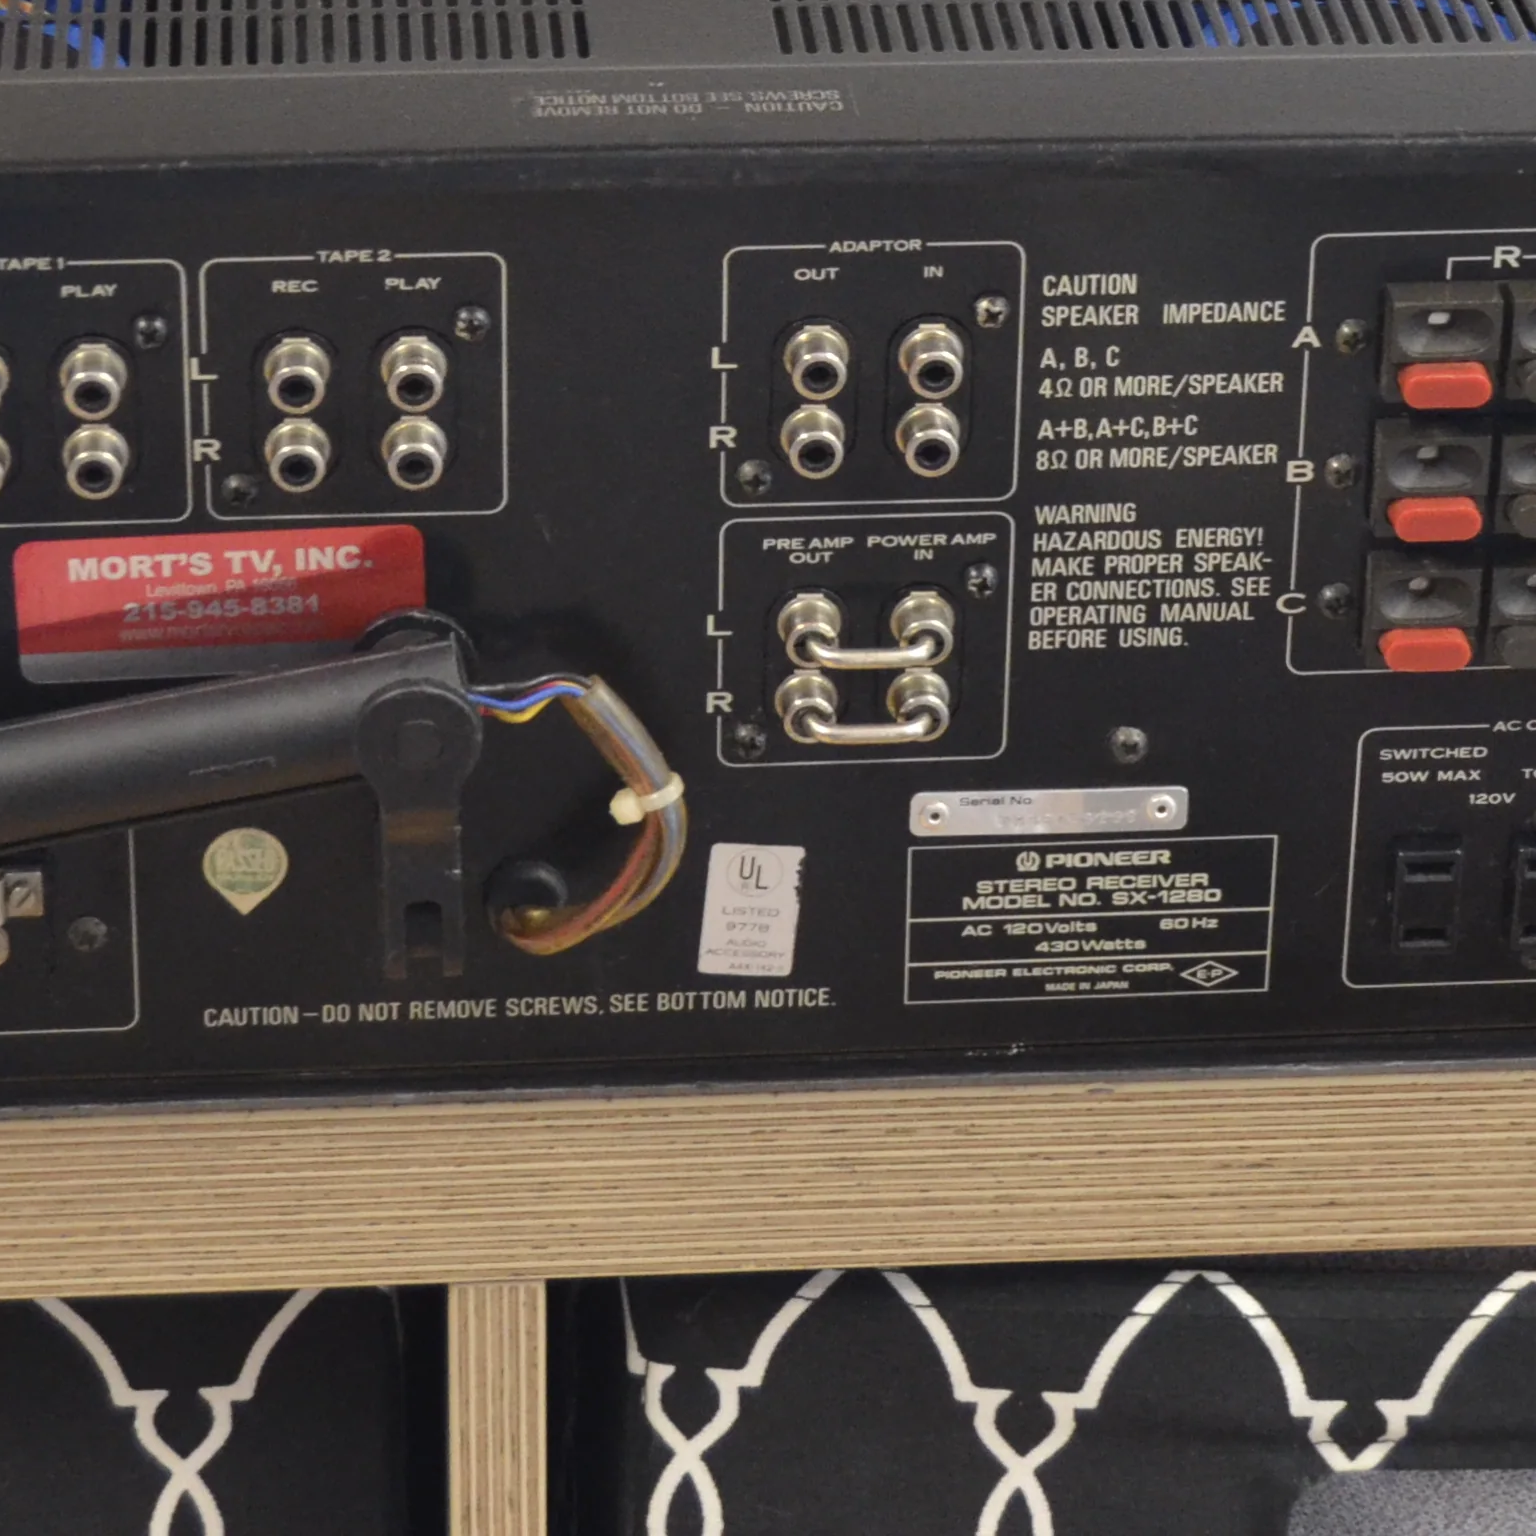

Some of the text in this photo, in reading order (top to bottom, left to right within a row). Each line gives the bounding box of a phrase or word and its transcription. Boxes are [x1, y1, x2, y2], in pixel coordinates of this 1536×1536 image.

[610, 91, 701, 105] BOTTOM
[744, 101, 845, 114] CAUTION
[531, 103, 620, 118] REMOVE
[626, 102, 667, 116] NOT
[673, 102, 704, 115] DO
[316, 249, 392, 263] TAPE 2
[829, 239, 922, 253] ADAPTOR
[55, 257, 65, 270] 1
[1493, 246, 1522, 268] R
[794, 267, 840, 282] OUT
[923, 265, 944, 279] IN
[60, 283, 117, 298] PLAY
[271, 279, 319, 294] REC
[384, 277, 441, 292] PLAY
[1043, 274, 1137, 297] CAUTION
[1041, 300, 1287, 328] SPEAKER IMPEDANCE
[1292, 326, 1322, 349] A
[710, 347, 738, 371] L
[1106, 346, 1120, 367] C
[190, 357, 218, 380] L
[1080, 376, 1107, 399] OR
[1114, 372, 1285, 398] MORE/SPEAKER
[709, 426, 738, 450] R
[193, 439, 222, 463] R
[1074, 448, 1102, 471] OR
[1109, 443, 1279, 470] MORE/SPEAKER
[1285, 460, 1315, 482] B
[1035, 503, 1137, 525] WARNING
[763, 536, 854, 551] PRE AMP
[867, 533, 997, 549] POWER AMP
[1032, 527, 1264, 552] HAZARDOUS ENERGY!
[67, 545, 373, 583] MORT'S TV, INC.
[789, 550, 833, 564] OUT
[914, 549, 934, 562] IN
[1030, 552, 1273, 578] MAKE PROPER SPEAK-
[1030, 576, 1271, 603] ER CONNECTIONS. SEE
[123, 594, 320, 624] 215-945-8381
[1275, 592, 1307, 614] C
[1029, 601, 1255, 627] OPERATING MANUAL
[706, 614, 733, 637] L
[1028, 626, 1189, 651] BEFORE USING.
[705, 691, 733, 714] R
[1493, 719, 1523, 733] AC
[1379, 746, 1488, 760] SWITCHED
[1382, 769, 1481, 783] 50W MAX
[959, 796, 1006, 807] Serial
[1469, 792, 1516, 804] 120V
[1046, 850, 1172, 869] PIONEER
[739, 855, 770, 890] UL
[976, 873, 1209, 894] STEREO RECEIVER
[963, 888, 1222, 910] MODEL NO. SX-1280
[721, 906, 780, 918] LISTED
[961, 924, 994, 937] AC
[934, 962, 1174, 981] PIONEER ELECTRONIC CORP.
[1045, 980, 1129, 992] MADE IN JAPAN
[359, 1002, 401, 1023] NOT
[409, 999, 498, 1020] REMOVE
[610, 992, 650, 1014] SEE
[656, 990, 748, 1012] BOTTOM
[754, 986, 836, 1009] NOTICE.
